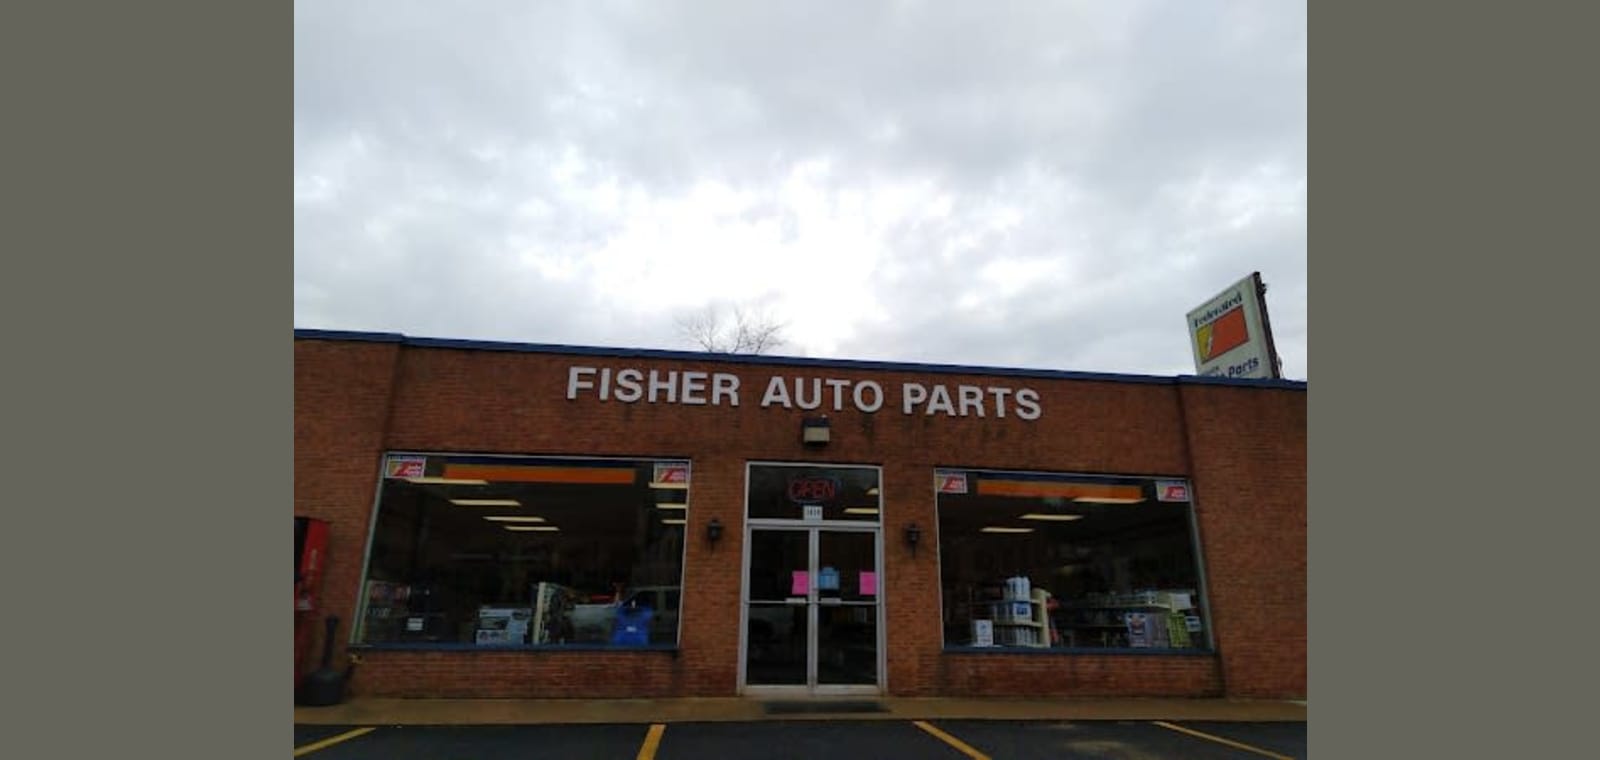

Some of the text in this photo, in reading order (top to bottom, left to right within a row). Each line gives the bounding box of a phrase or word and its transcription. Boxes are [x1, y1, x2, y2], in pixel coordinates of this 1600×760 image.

[567, 366, 1042, 420] FISHER AUTO PARTS
[788, 479, 836, 498] OPEN
